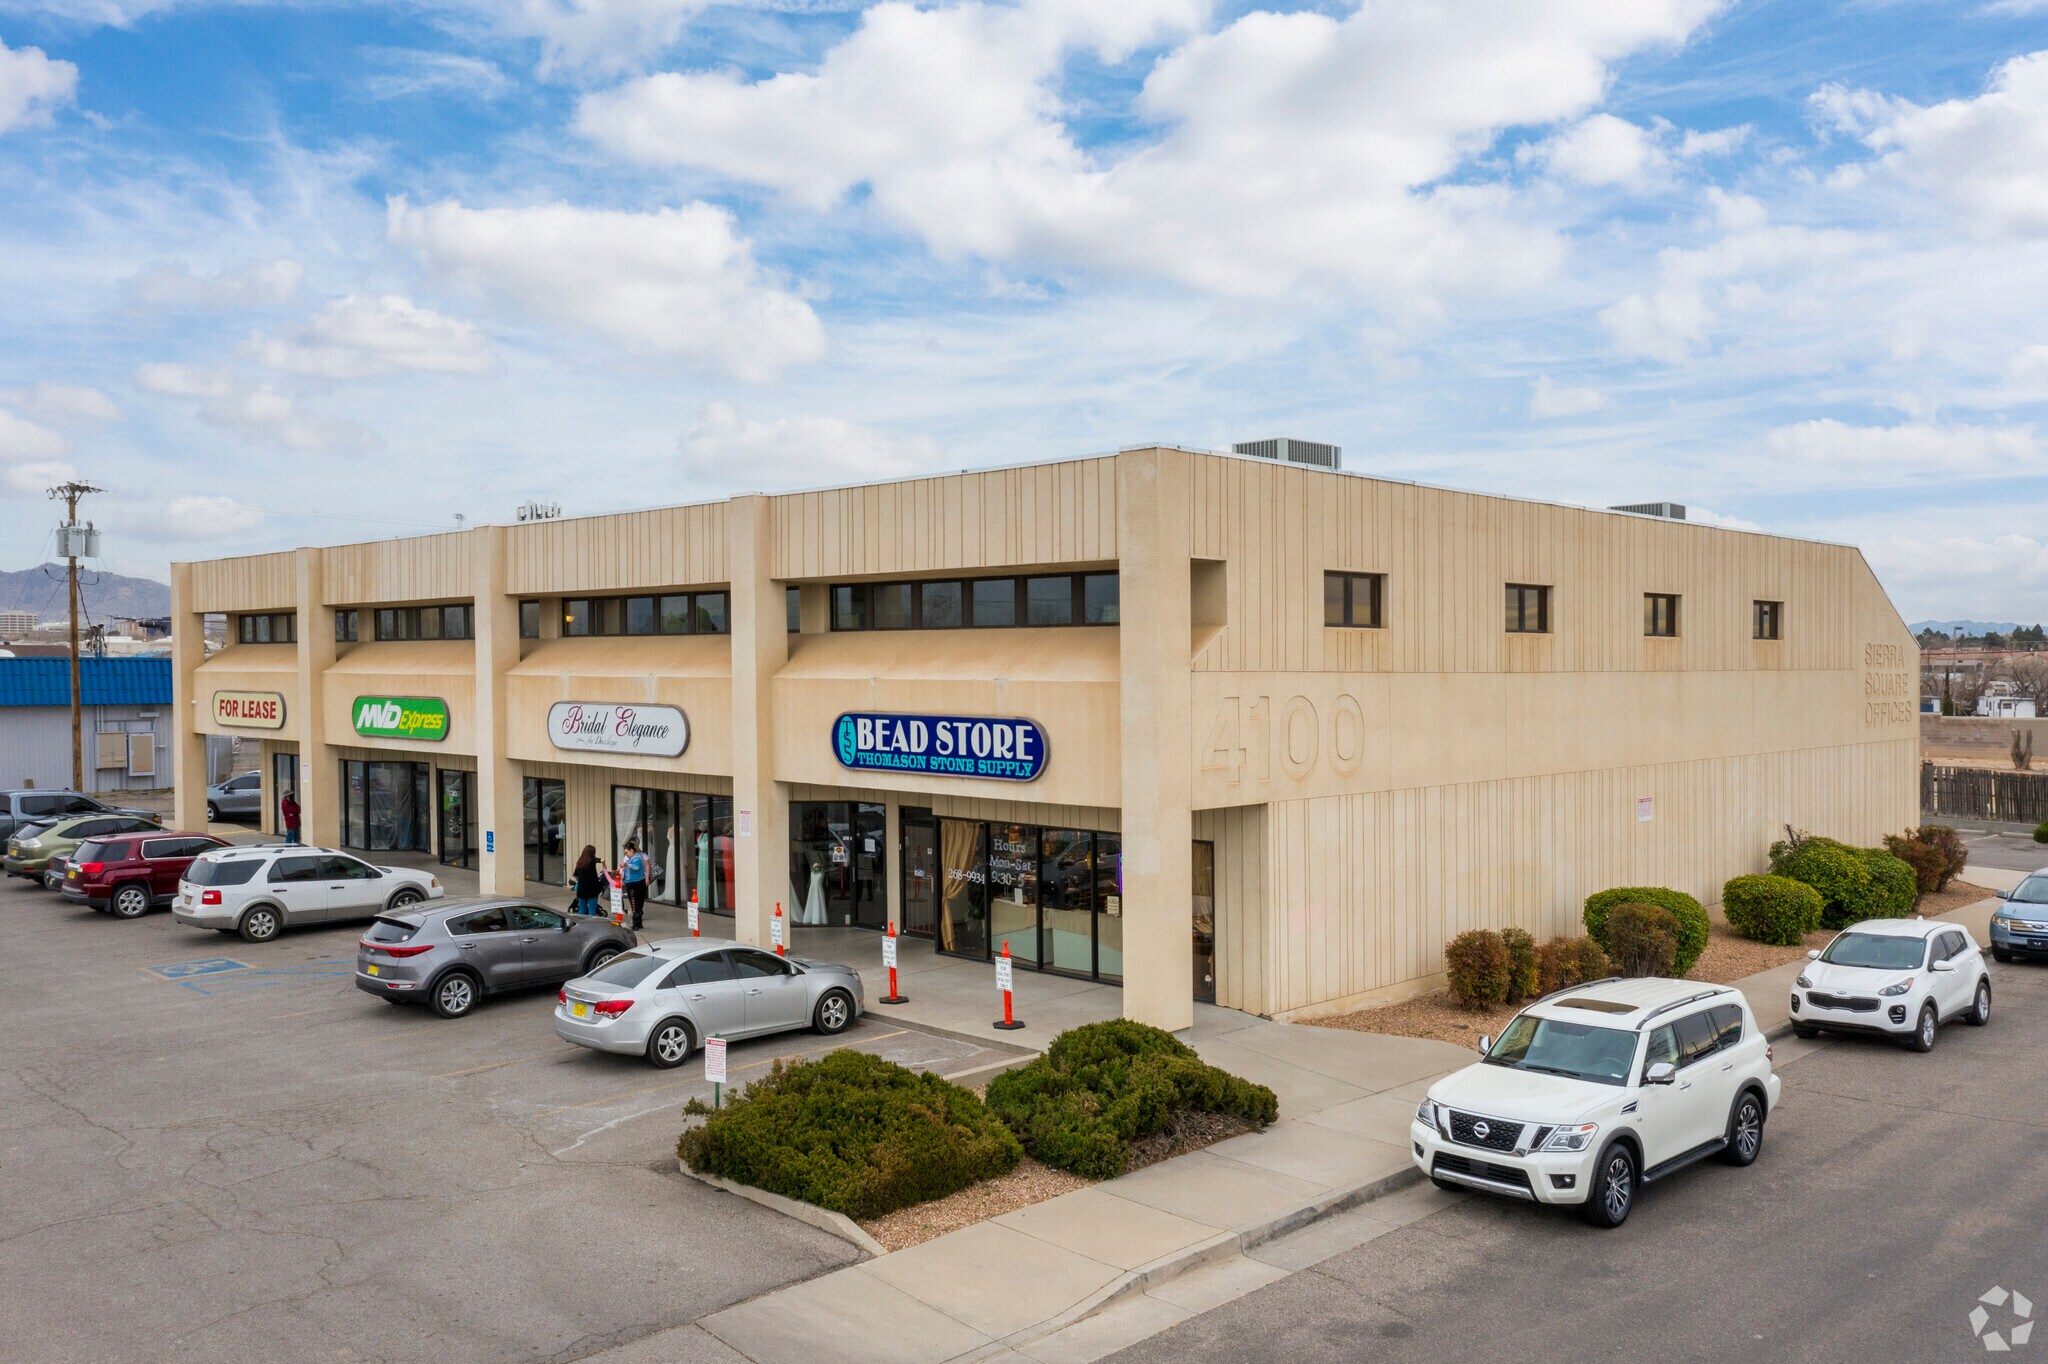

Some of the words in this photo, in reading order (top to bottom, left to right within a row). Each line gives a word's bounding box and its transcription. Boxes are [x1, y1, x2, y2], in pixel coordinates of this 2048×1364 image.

[1864, 642, 1905, 668] SIERRA
[1864, 672, 1909, 696] SQUARE
[219, 699, 239, 718] FOR
[242, 700, 277, 720] LEASE
[355, 700, 402, 730] MVD
[398, 710, 445, 735] Express
[1864, 700, 1912, 727] OFFICES
[562, 704, 609, 735] Bridal
[614, 706, 670, 748] Elegance
[1200, 693, 1365, 785] 4100
[857, 718, 929, 753] BEAD
[935, 721, 1034, 761] STORE
[857, 752, 927, 769] THOMASON
[930, 756, 975, 772] STONE
[977, 759, 1034, 777] SUPPLY
[993, 838, 1026, 854] Hours
[948, 868, 986, 885] 268-9934
